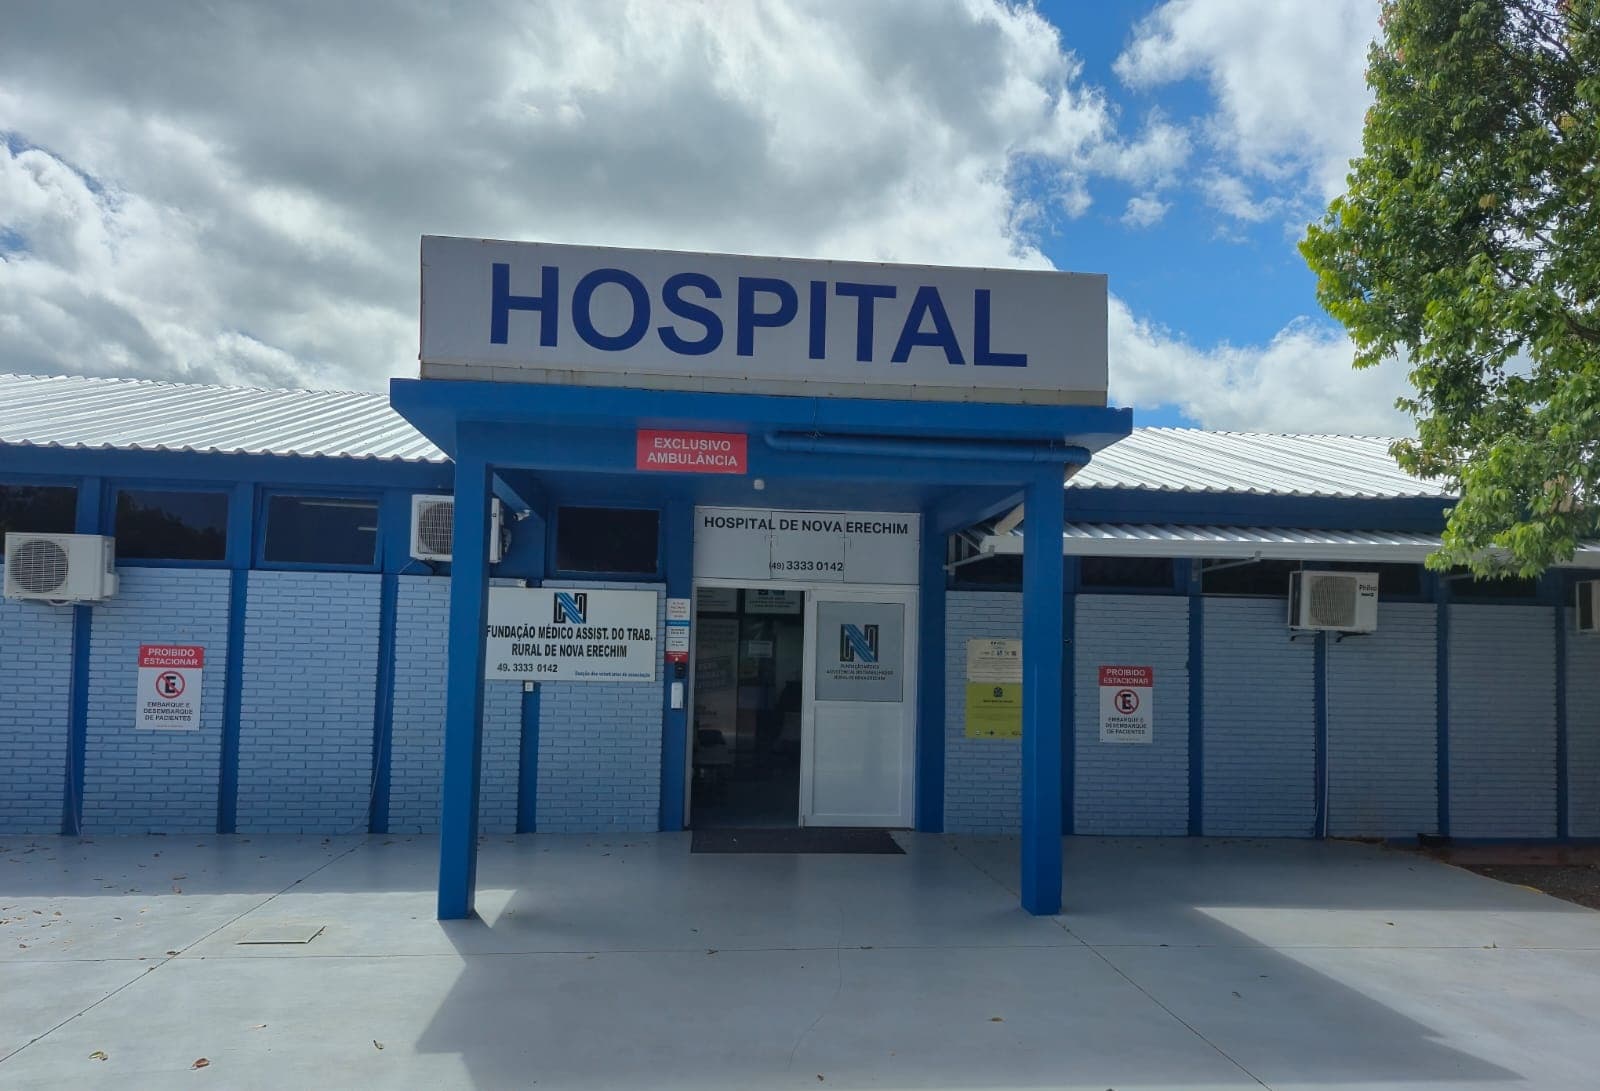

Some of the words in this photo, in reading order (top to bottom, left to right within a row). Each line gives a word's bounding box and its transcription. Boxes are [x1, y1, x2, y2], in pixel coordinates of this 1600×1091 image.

[490, 262, 1028, 368] HOSPITAL
[653, 437, 732, 452] EXCLUSIVO
[647, 451, 739, 467] AMBULÂNCIA
[704, 515, 776, 531] HOSPITAL
[779, 518, 799, 531] DE
[801, 519, 843, 533] NOVA
[845, 521, 909, 535] ERECHIM
[769, 561, 785, 571] (49)
[786, 560, 814, 571] 3333
[816, 561, 844, 572] 0142
[486, 623, 536, 642] FUNDAÇÃO
[538, 624, 574, 640] MÉDICO
[576, 627, 609, 640] ASSIST.
[611, 628, 625, 641] DO
[627, 628, 653, 641] TRAB.
[148, 648, 195, 656] PROIBIDO
[511, 643, 542, 657] RURAL
[544, 644, 557, 657] DE
[559, 645, 584, 657] NOVA
[586, 645, 628, 657] ERECHIM
[496, 663, 511, 672] 49.
[513, 663, 534, 672] 3333
[536, 664, 558, 673] 0142
[1106, 668, 1146, 677] PROIBIDO
[1103, 677, 1149, 685] ESTACIONAR
